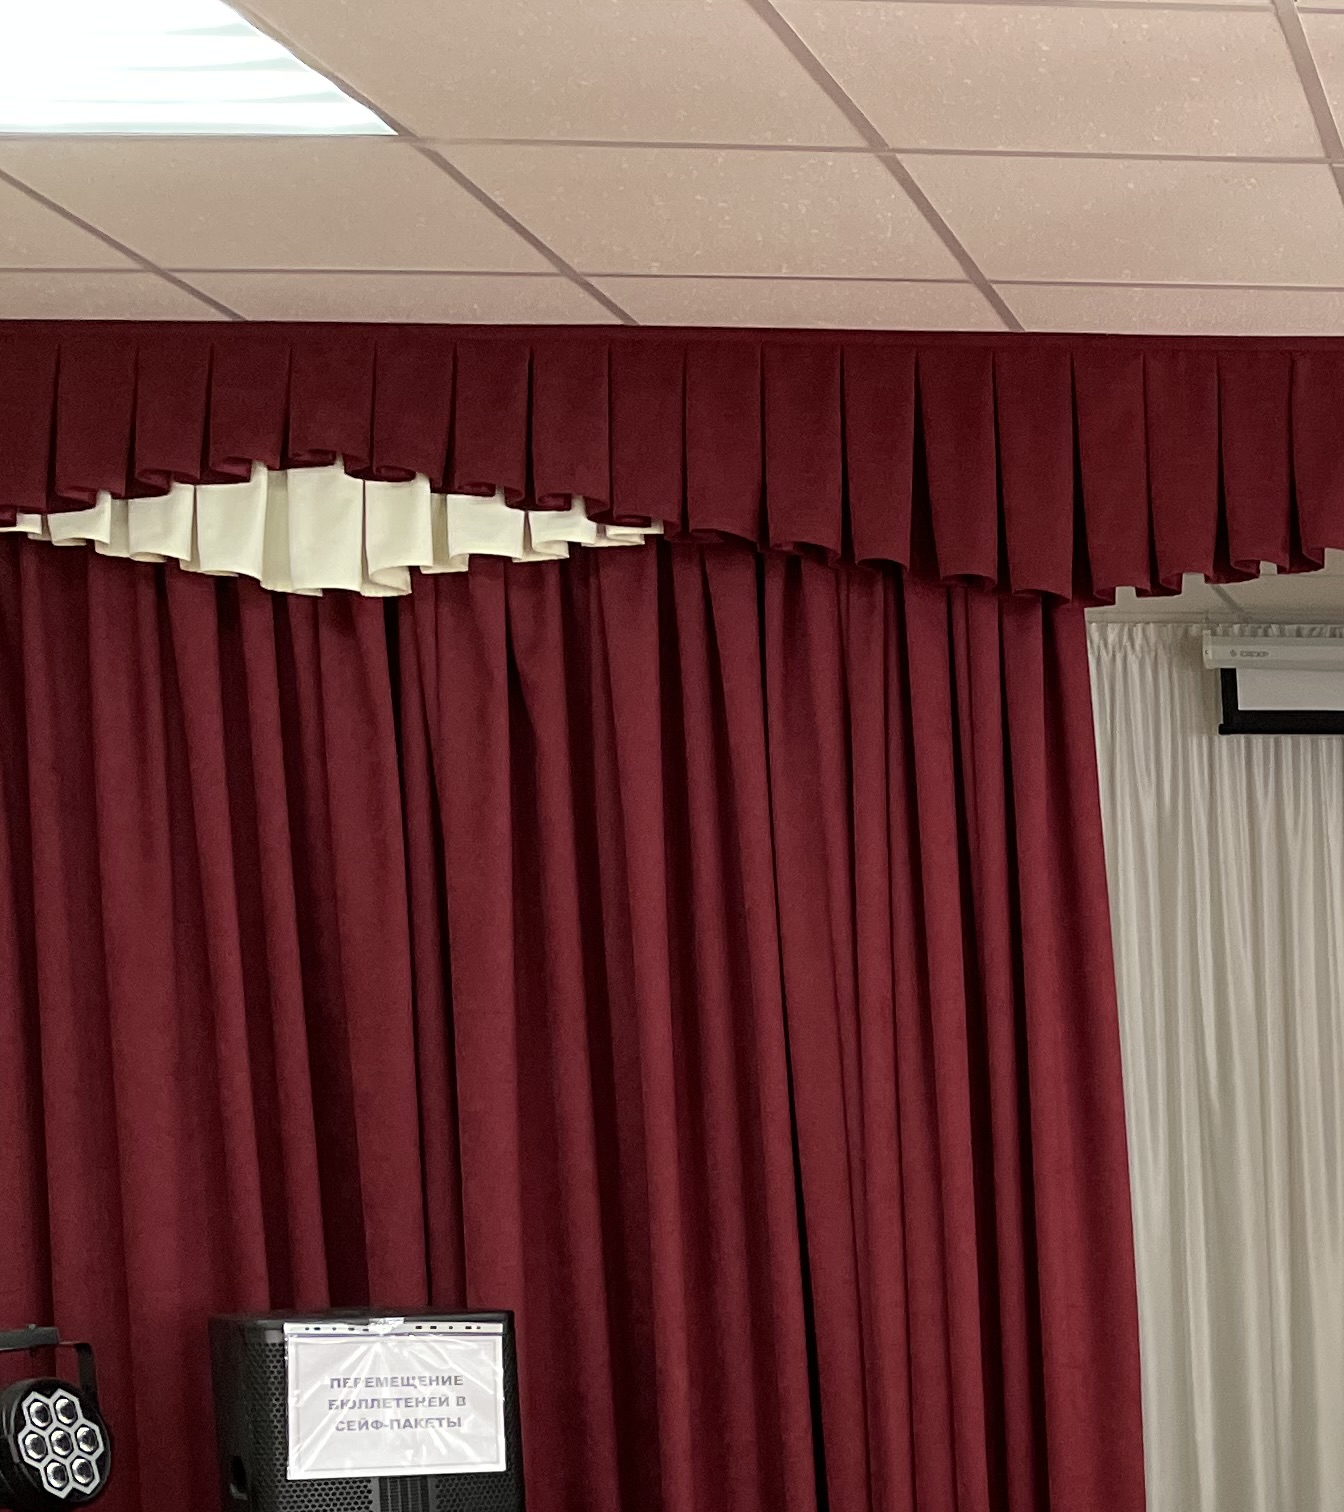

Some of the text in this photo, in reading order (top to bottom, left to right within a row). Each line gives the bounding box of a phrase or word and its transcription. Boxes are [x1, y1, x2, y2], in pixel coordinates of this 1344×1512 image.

[329, 1375, 464, 1389] ПЕРЕМЕЩЕНИЕ
[327, 1393, 467, 1410] БЮЛЛЕТЕНЕЙ В
[335, 1416, 463, 1432] СЕЙФ-ПАКЕТЫ
